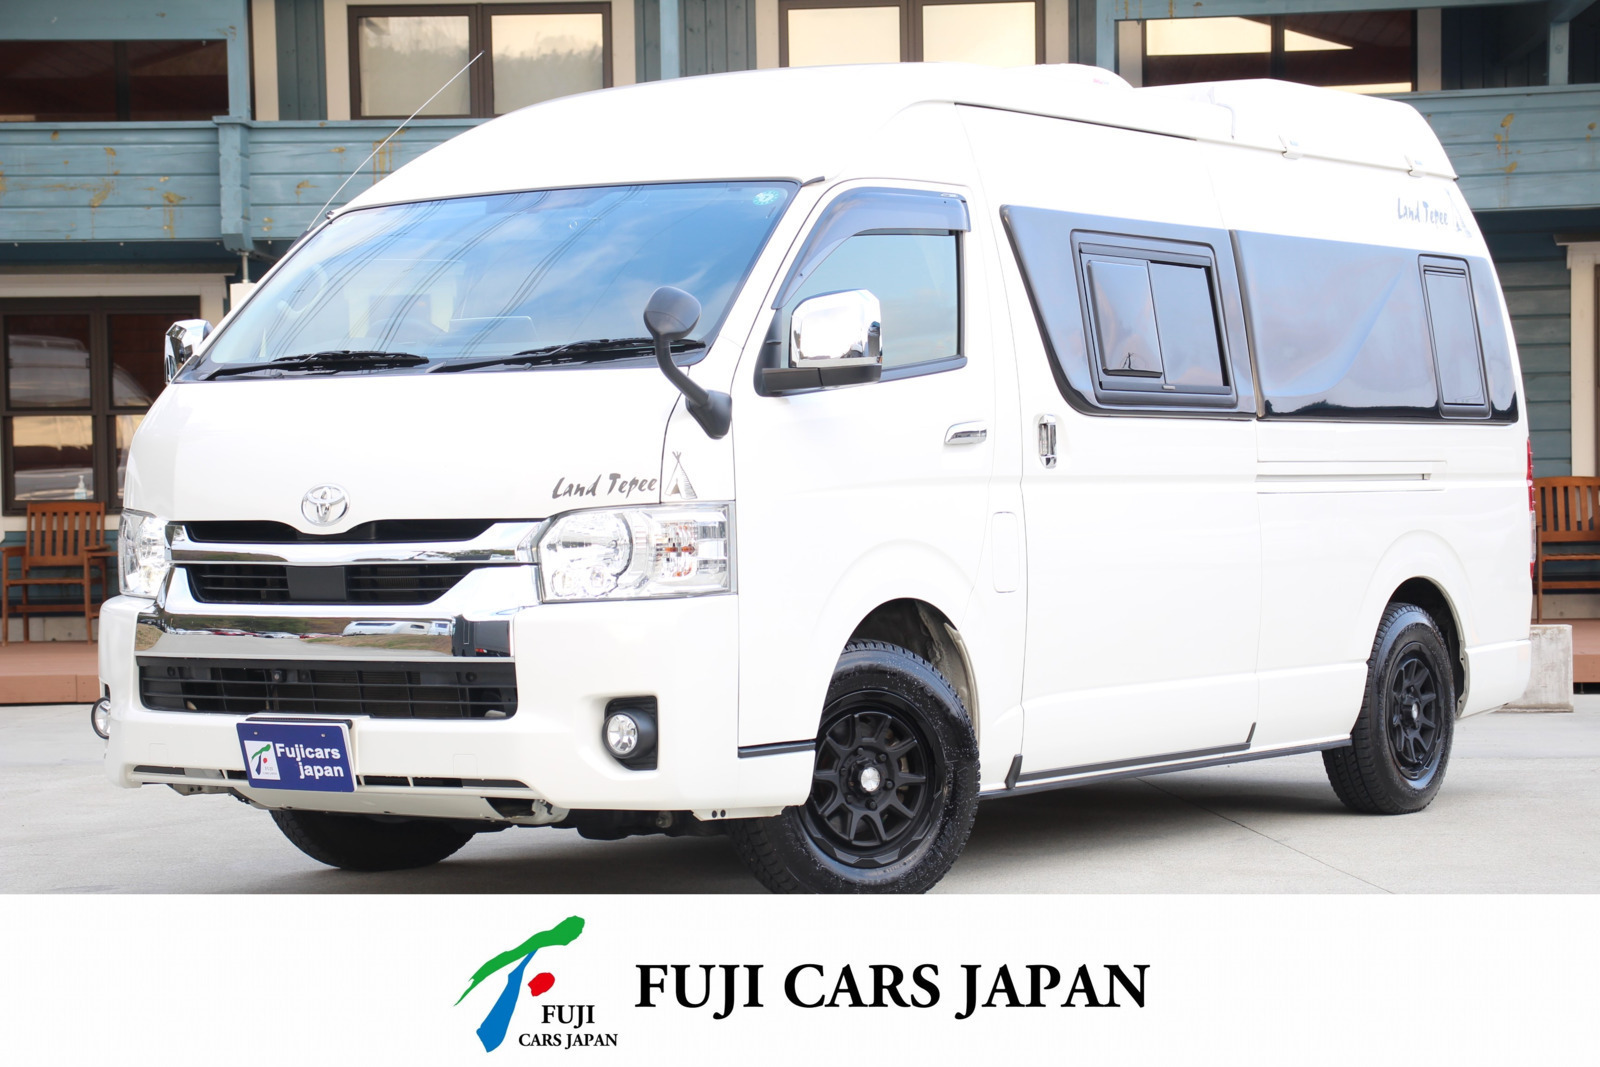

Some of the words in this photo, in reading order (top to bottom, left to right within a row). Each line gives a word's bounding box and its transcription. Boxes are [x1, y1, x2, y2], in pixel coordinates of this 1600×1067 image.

[1397, 197, 1420, 222] Land
[552, 474, 602, 499] Land
[607, 473, 657, 498] Tepee
[275, 743, 341, 761] Fujicars
[299, 762, 344, 779] japan
